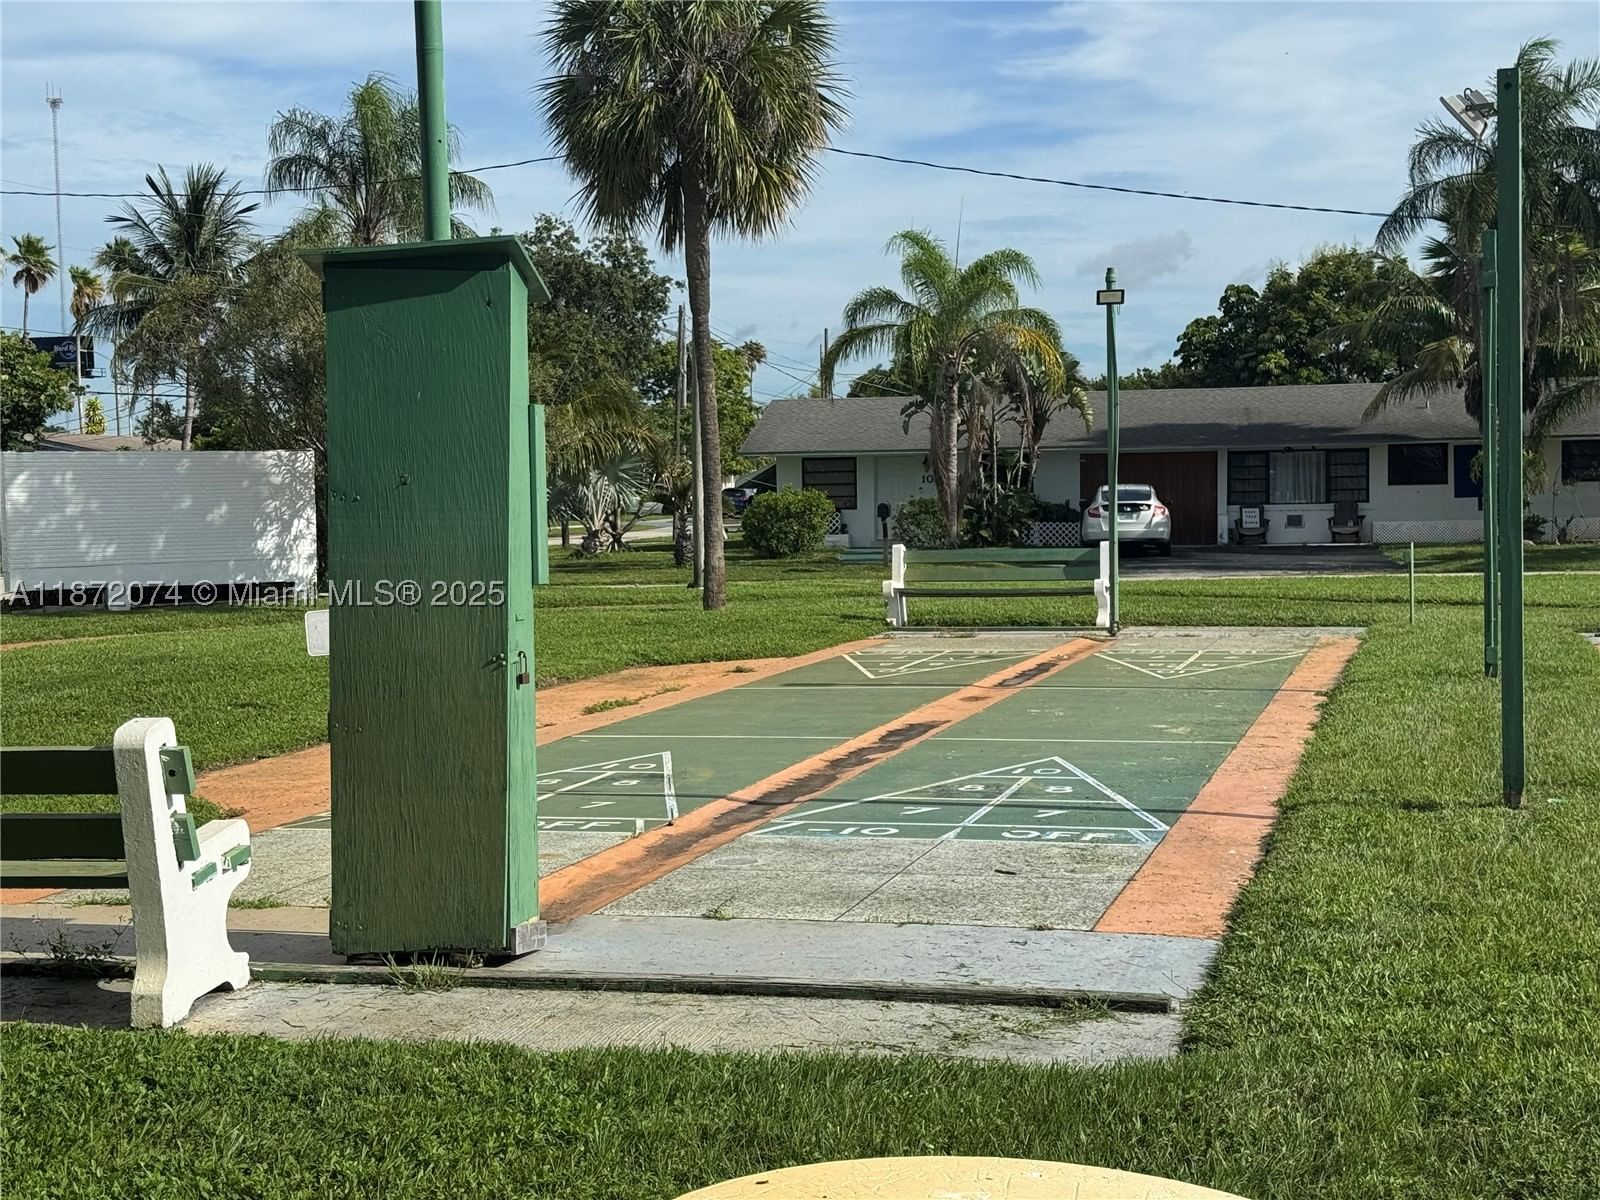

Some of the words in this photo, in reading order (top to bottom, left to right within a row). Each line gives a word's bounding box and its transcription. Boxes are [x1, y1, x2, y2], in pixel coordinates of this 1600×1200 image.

[1011, 767, 1062, 775] 10
[1045, 785, 1073, 793] 8
[900, 806, 941, 815] 7
[1033, 809, 1071, 818] 7
[1001, 830, 1117, 840] OFF
